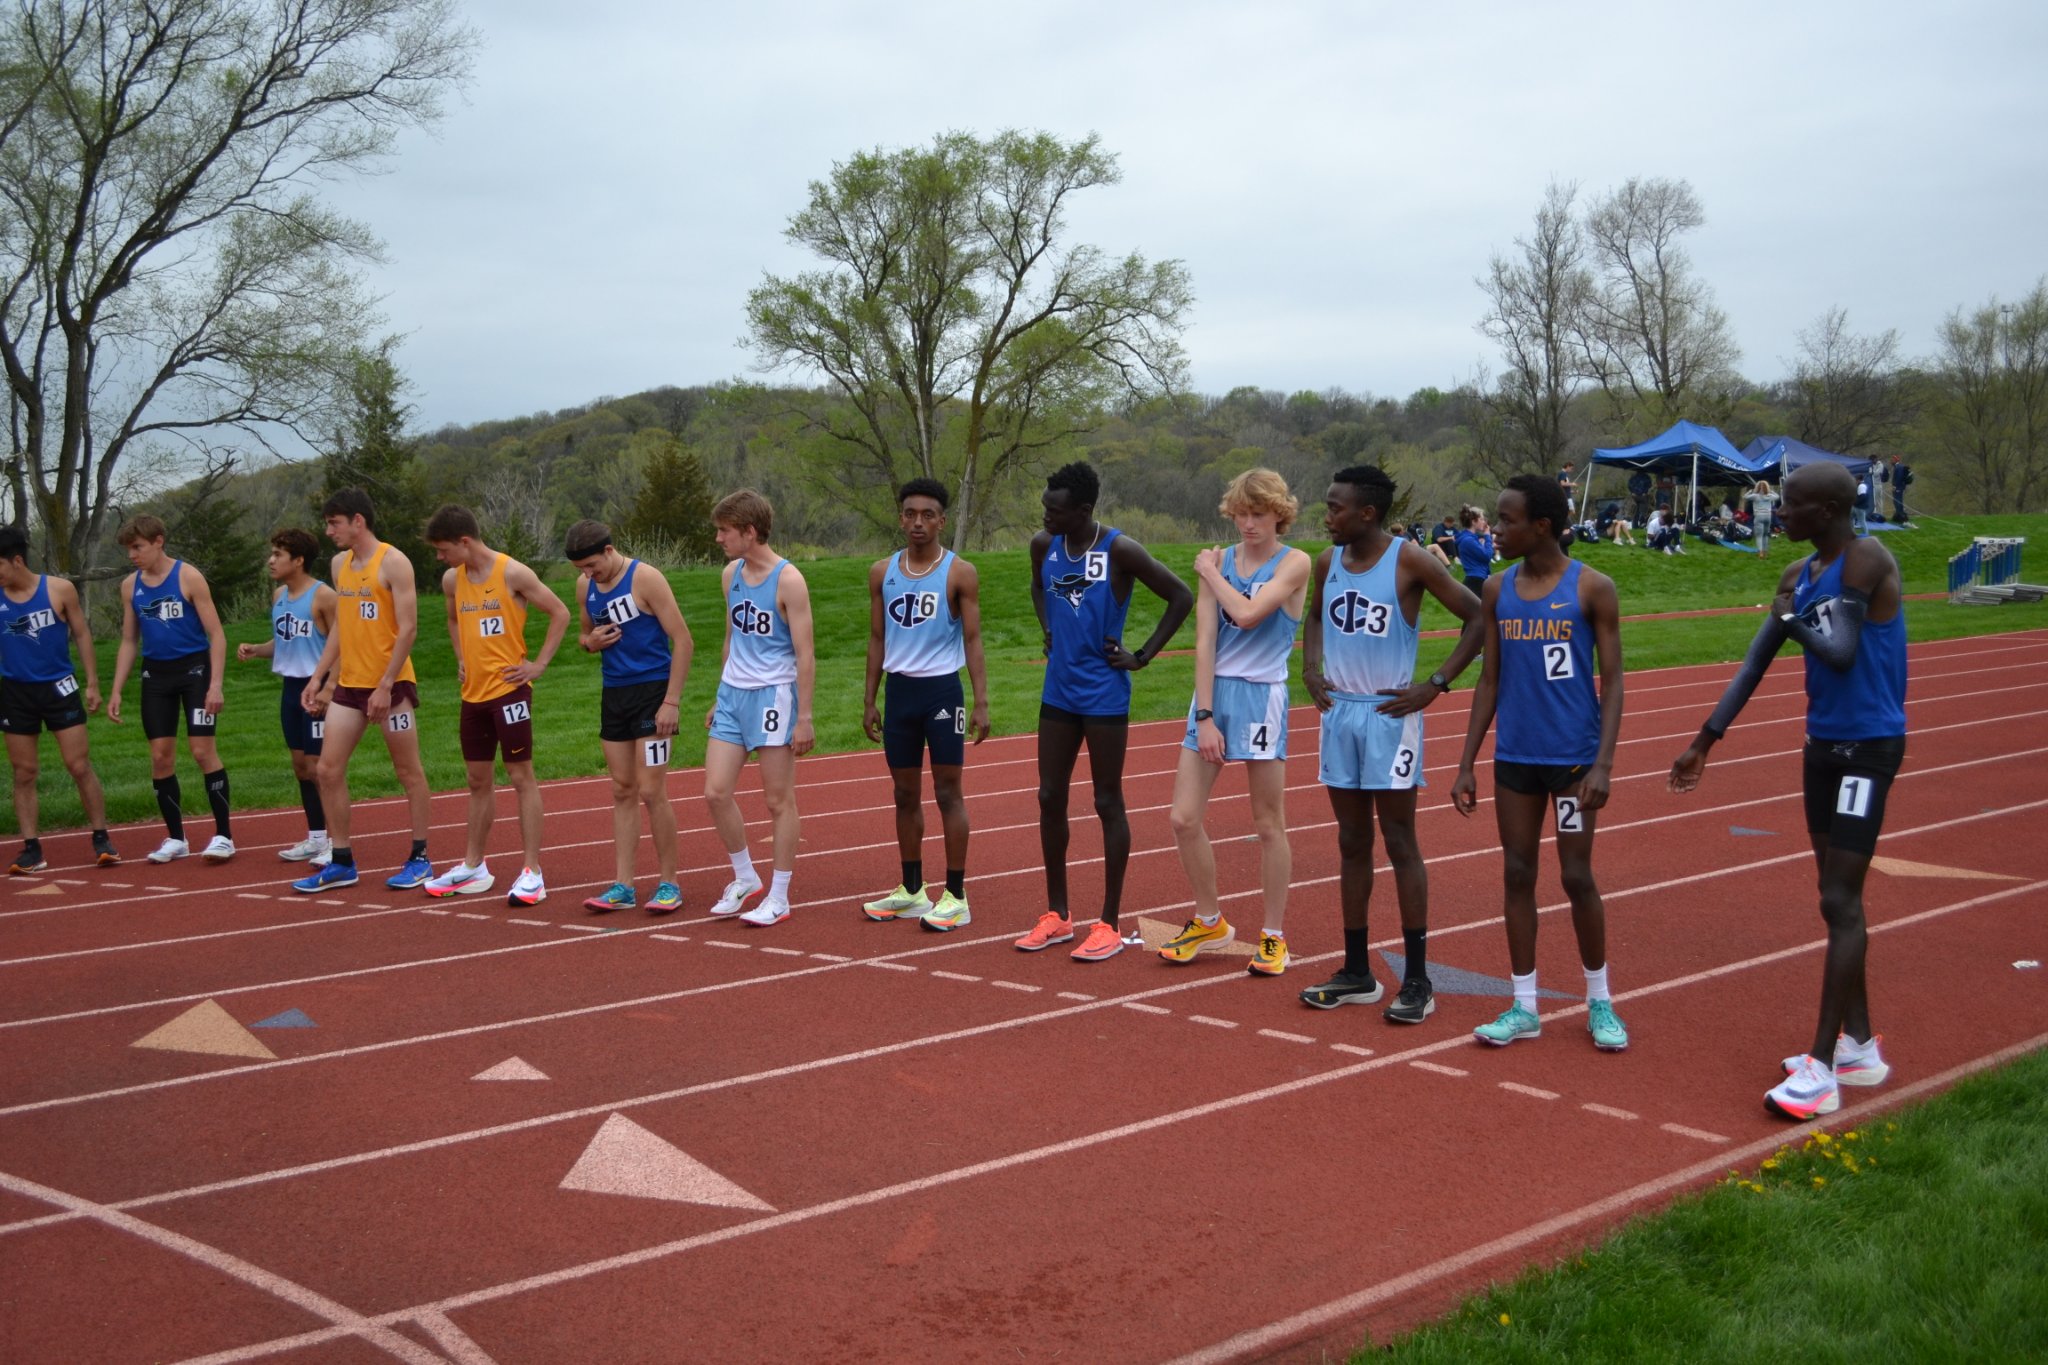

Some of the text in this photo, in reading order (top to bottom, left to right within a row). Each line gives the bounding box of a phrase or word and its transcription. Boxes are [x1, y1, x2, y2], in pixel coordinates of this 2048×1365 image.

[1087, 554, 1103, 579] 5
[164, 602, 179, 618] 16
[361, 602, 375, 619] 13
[610, 598, 633, 622] 11
[920, 593, 935, 617] 6
[1821, 604, 1832, 628] 1
[31, 611, 49, 628] 17
[294, 620, 309, 636] 14
[481, 618, 501, 636] 12
[757, 612, 771, 634] 8
[1367, 605, 1387, 634] 3
[1498, 619, 1573, 641] TROJANS
[1547, 646, 1568, 678] 2
[58, 677, 75, 694] 17
[198, 710, 211, 724] 16
[390, 713, 409, 731] 13
[506, 702, 527, 722] 12
[764, 709, 779, 732] 8
[957, 709, 964, 732] 6
[1252, 725, 1268, 752] 4
[648, 740, 667, 764] 11
[1394, 748, 1414, 778] 3
[1844, 779, 1860, 812] 1
[1559, 800, 1578, 830] 2
